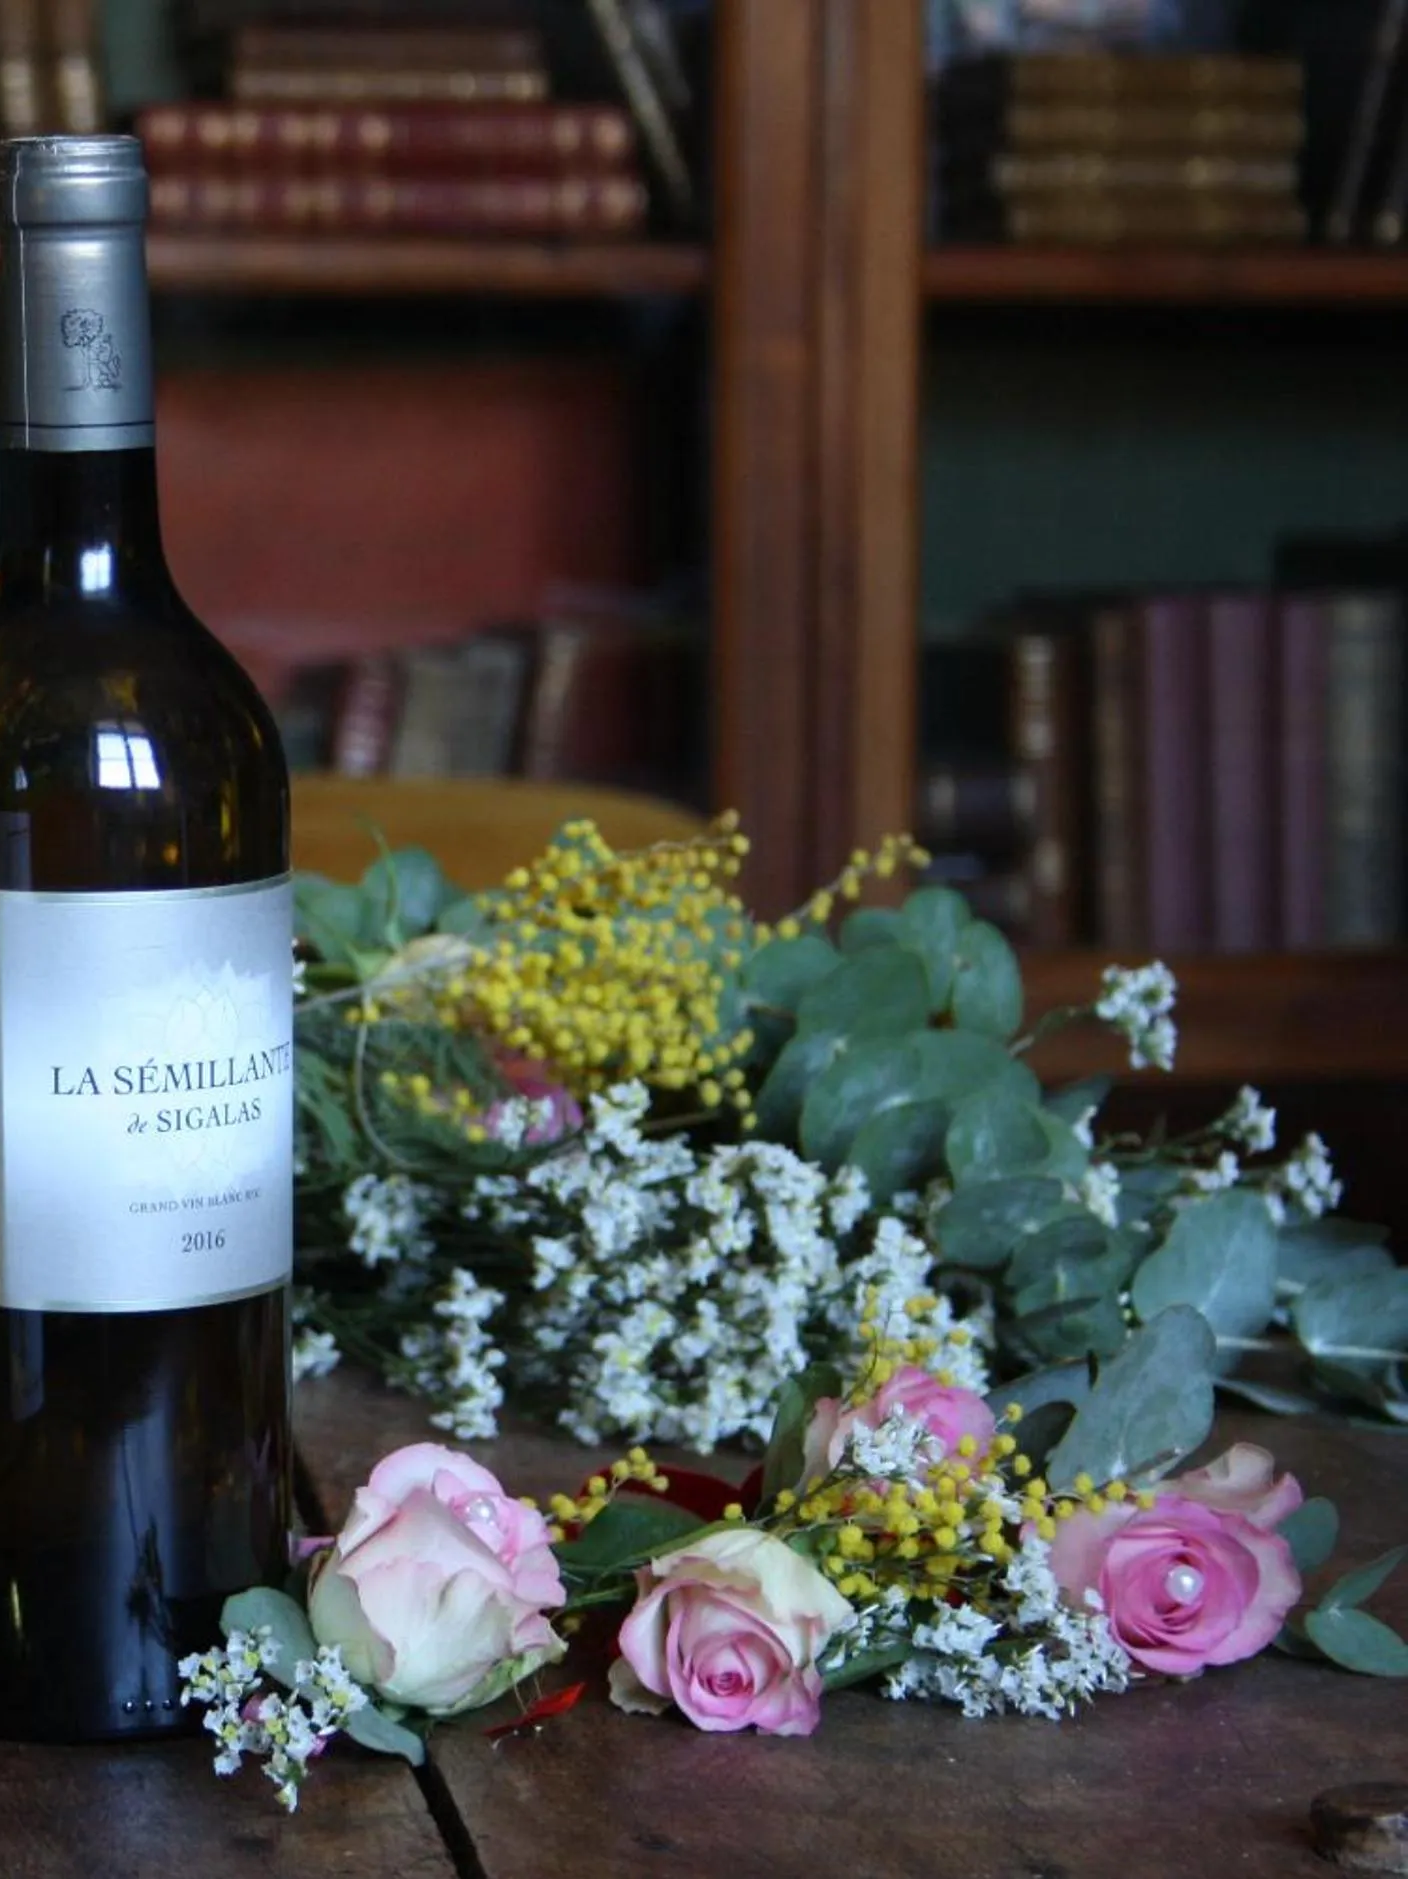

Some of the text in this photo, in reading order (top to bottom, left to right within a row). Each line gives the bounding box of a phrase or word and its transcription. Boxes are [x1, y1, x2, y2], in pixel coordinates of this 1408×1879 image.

[50, 1041, 290, 1096] LA SÉMILLANTE
[127, 1098, 262, 1134] de SIGALAS
[129, 1200, 179, 1214] GRAND
[181, 1195, 204, 1210] VIN
[181, 1229, 226, 1253] 2016
